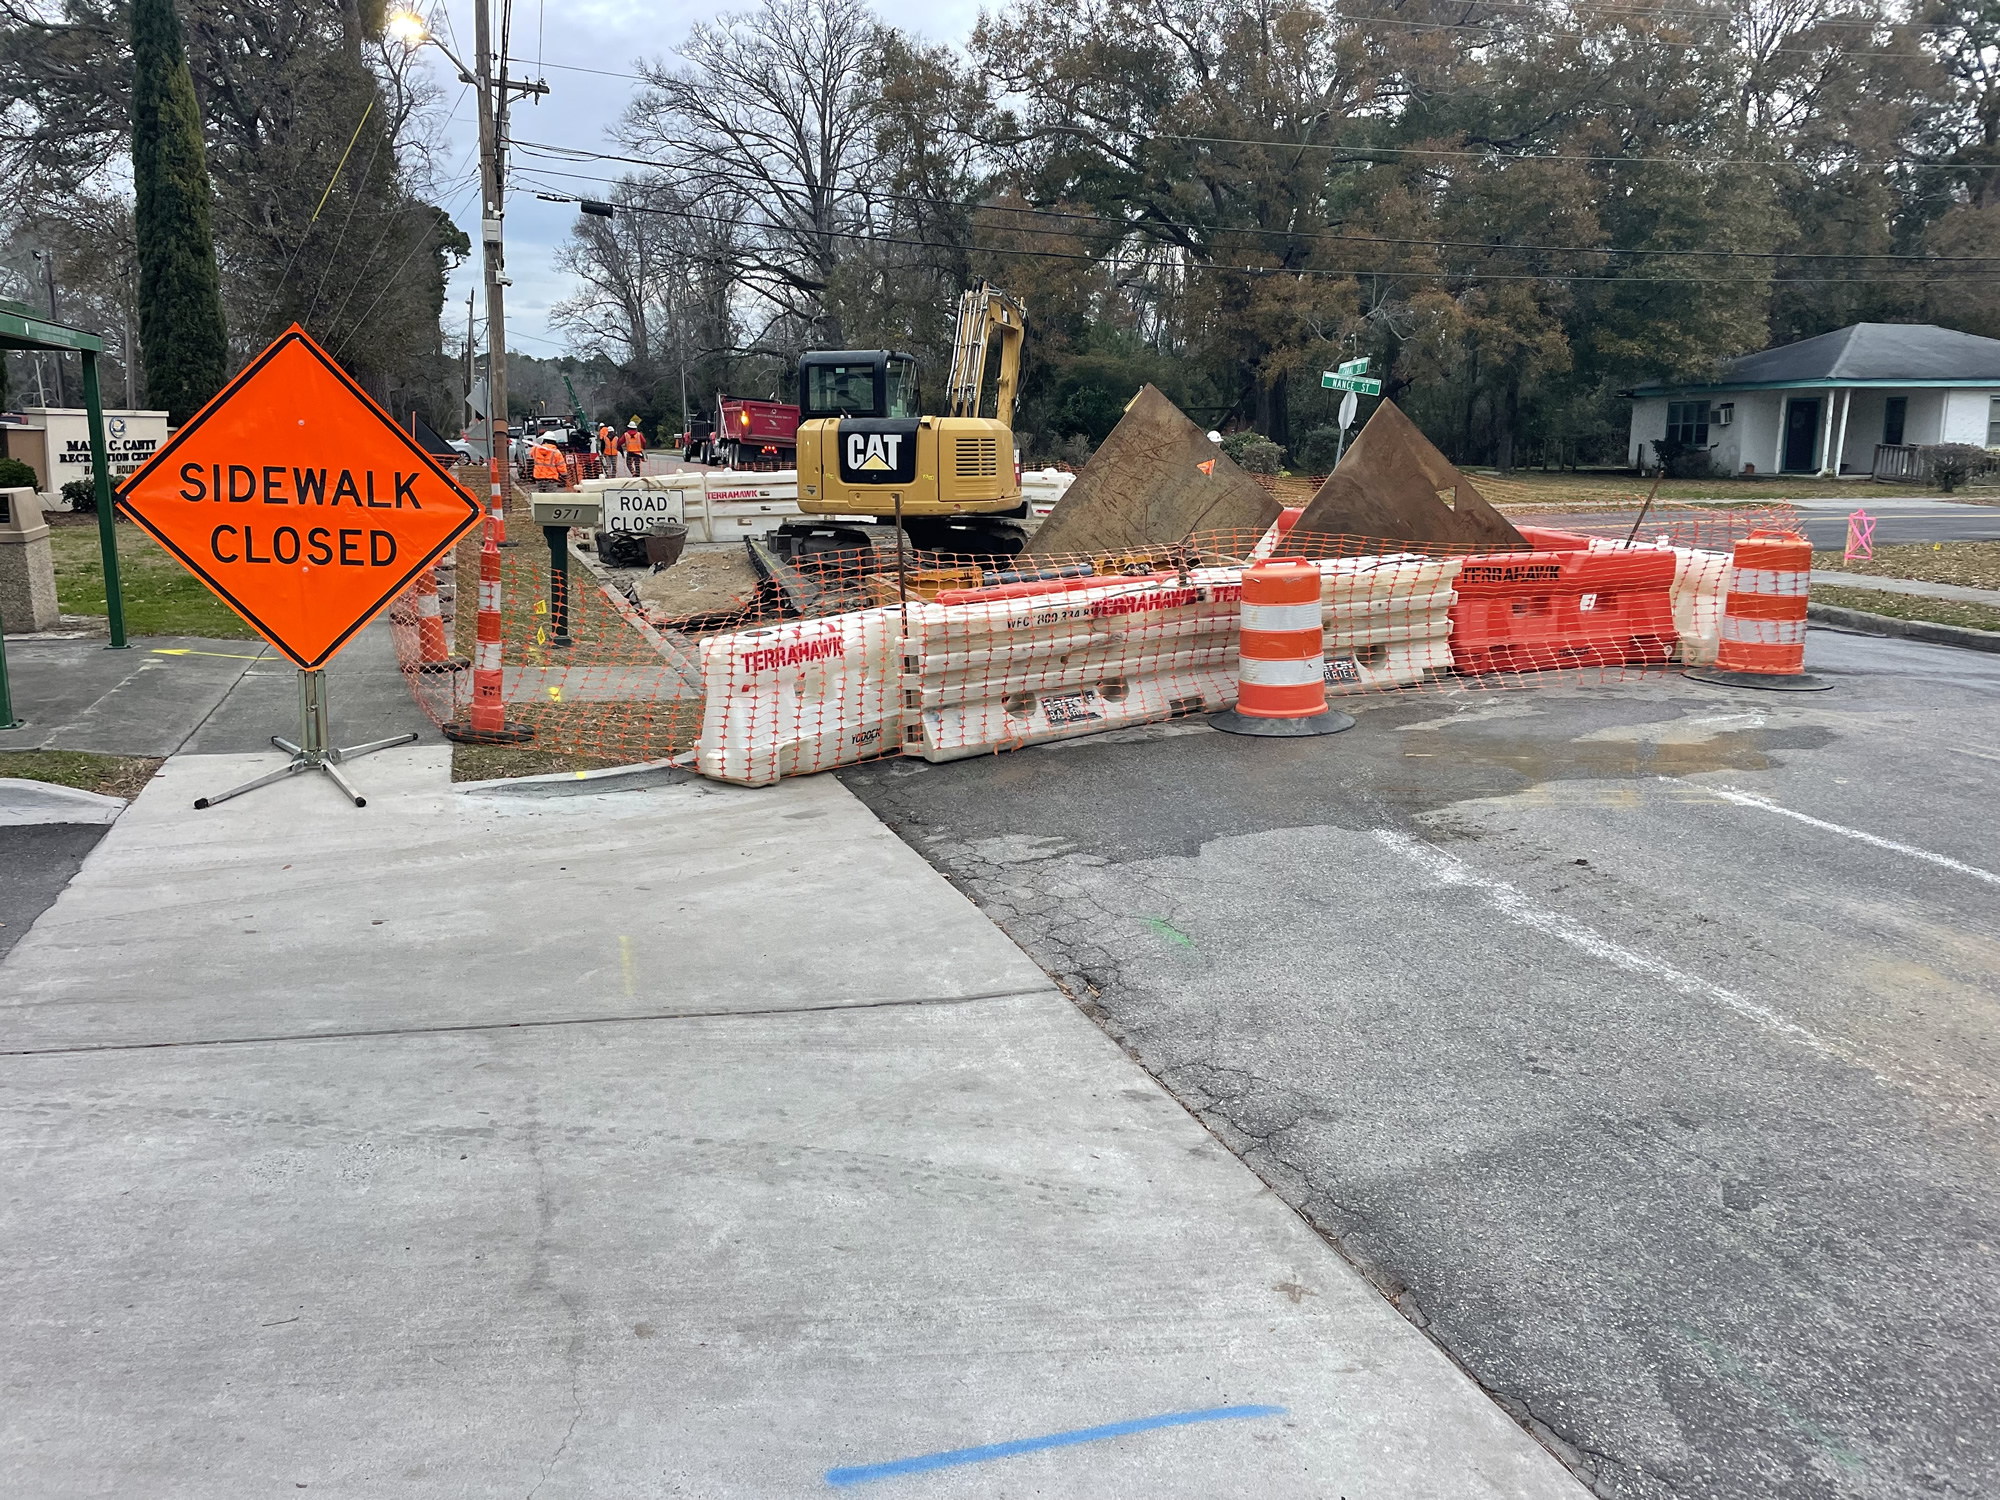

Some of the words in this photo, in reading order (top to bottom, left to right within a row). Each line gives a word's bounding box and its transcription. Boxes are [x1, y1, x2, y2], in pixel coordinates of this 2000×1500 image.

[1332, 379, 1355, 391] NANCE
[1361, 383, 1370, 392] ST
[109, 440, 121, 451] C.
[123, 440, 156, 450] CANTY
[847, 433, 902, 470] CAT
[59, 452, 129, 463] RECRTION
[179, 462, 421, 509] SIDEWALK
[706, 490, 758, 500] TERRAHAWK
[620, 497, 667, 511] ROAD
[552, 509, 579, 520] 971
[211, 524, 397, 566] CLOSED
[1463, 565, 1561, 583] TERRAHAWK
[741, 636, 844, 673] TERRAHAWK
